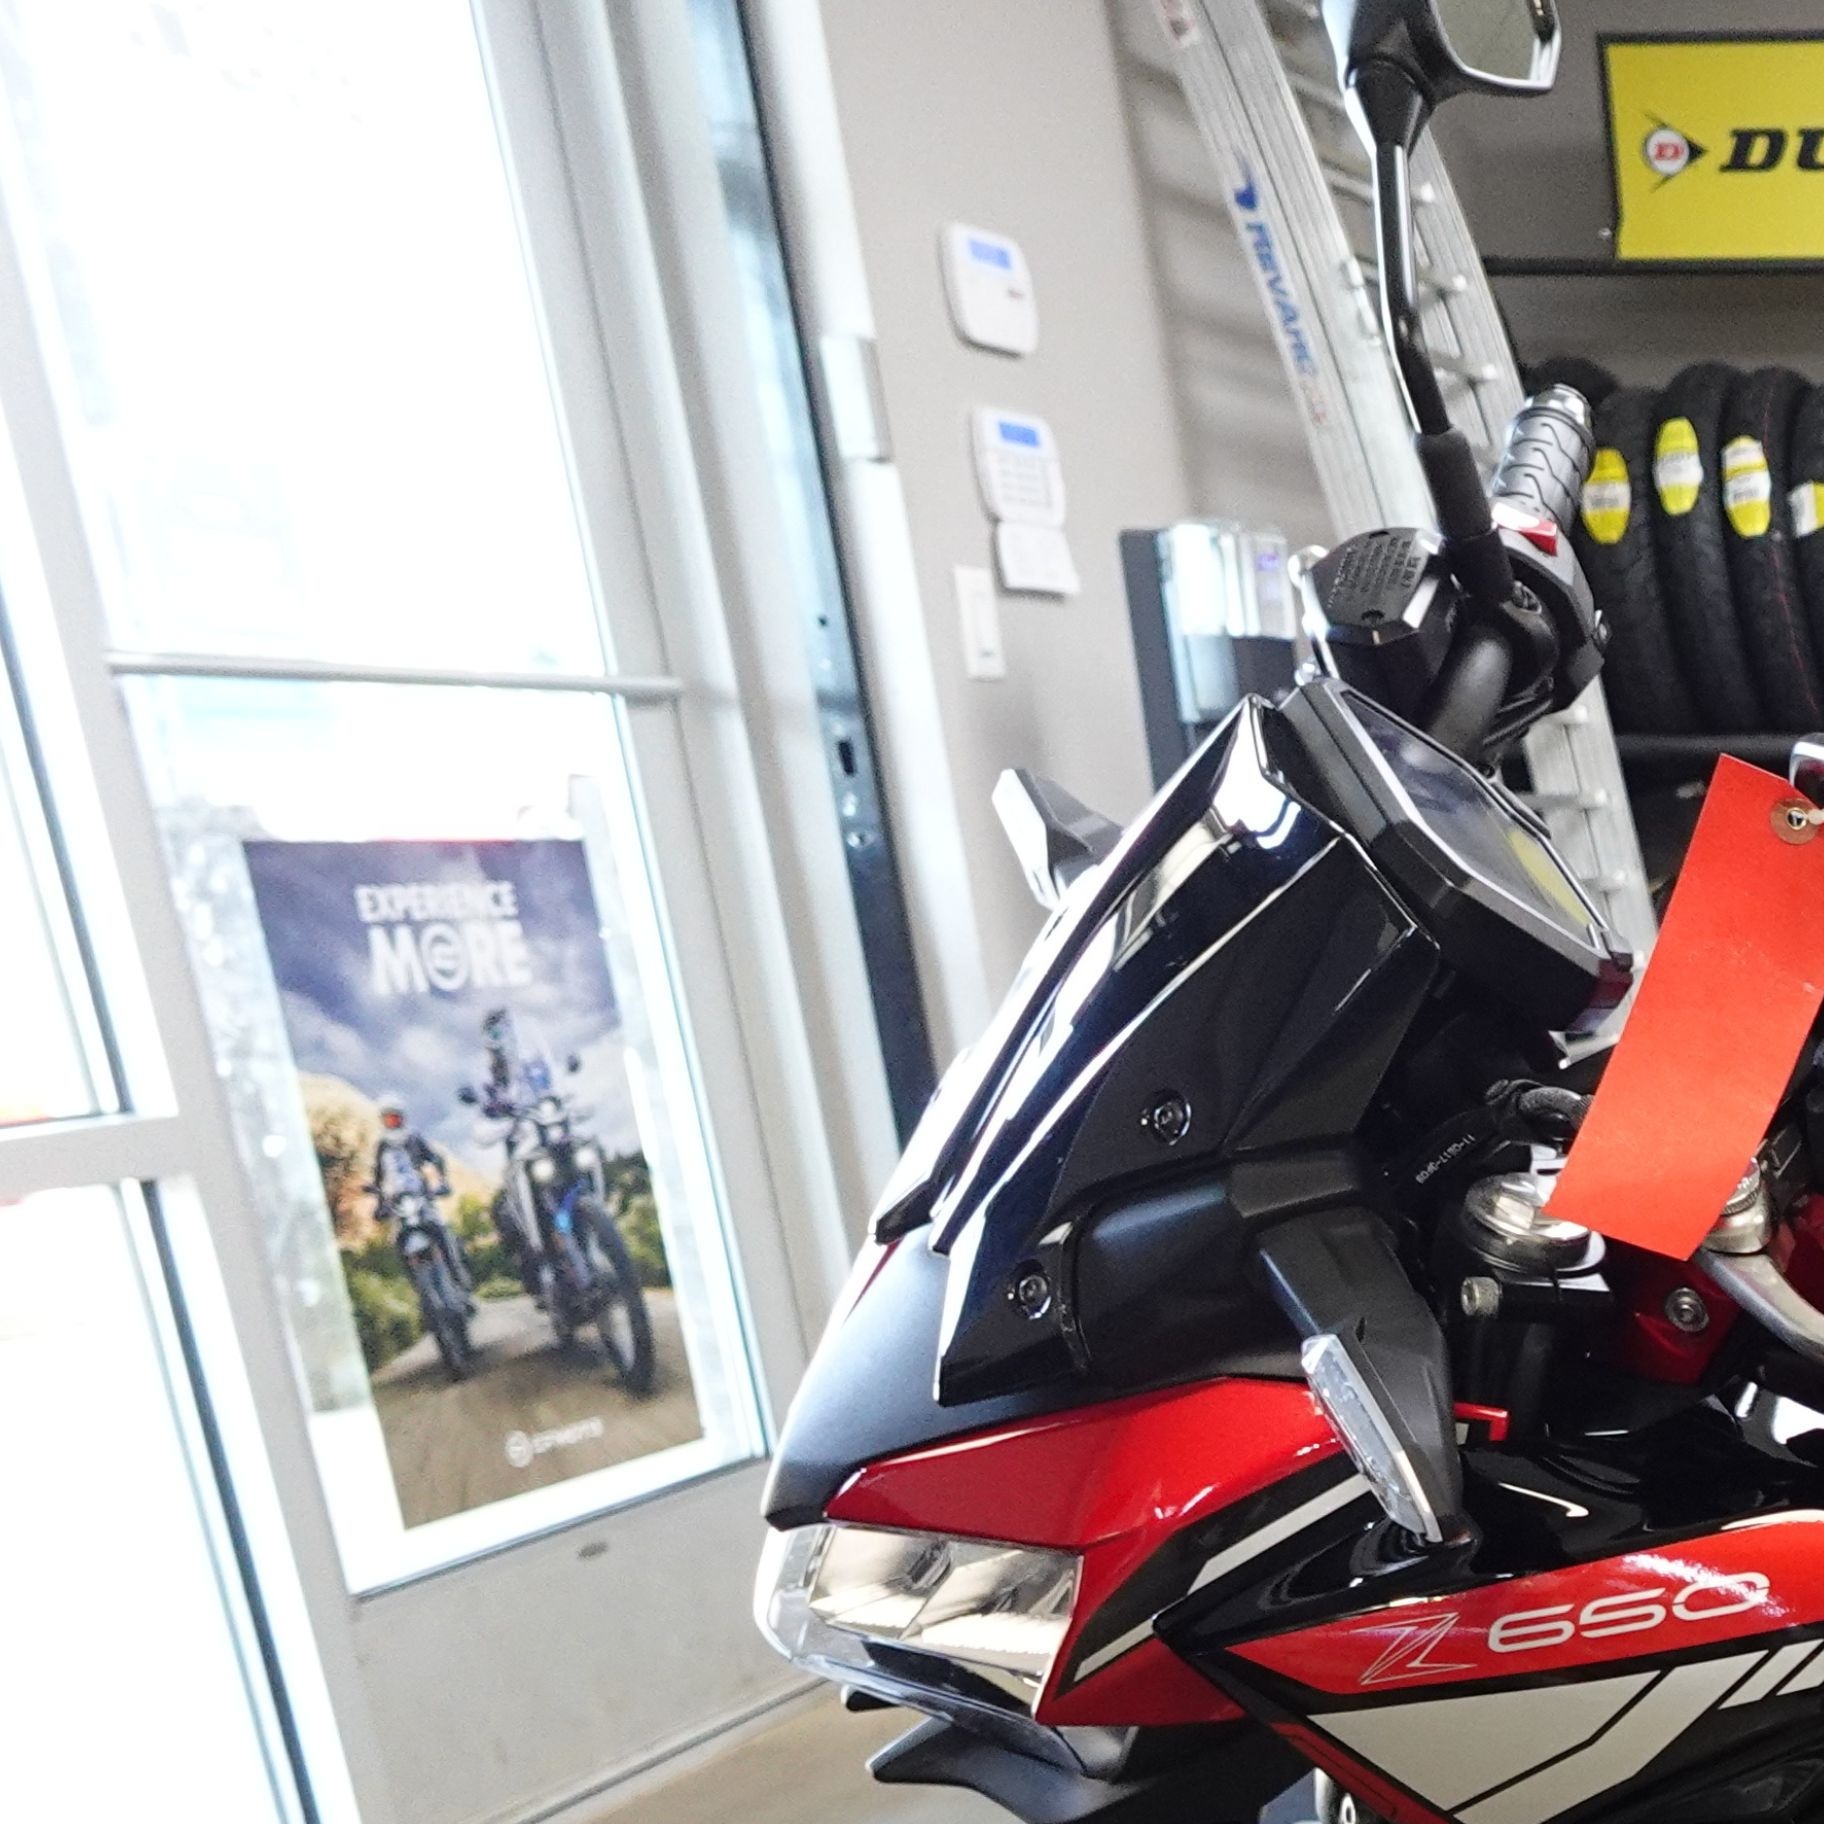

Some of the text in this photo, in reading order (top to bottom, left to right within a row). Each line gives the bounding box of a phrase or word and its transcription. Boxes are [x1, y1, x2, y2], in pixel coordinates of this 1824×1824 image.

[353, 880, 520, 923] EXPERIENCE
[367, 918, 534, 997] MORE
[1487, 1570, 1772, 1654] 650
